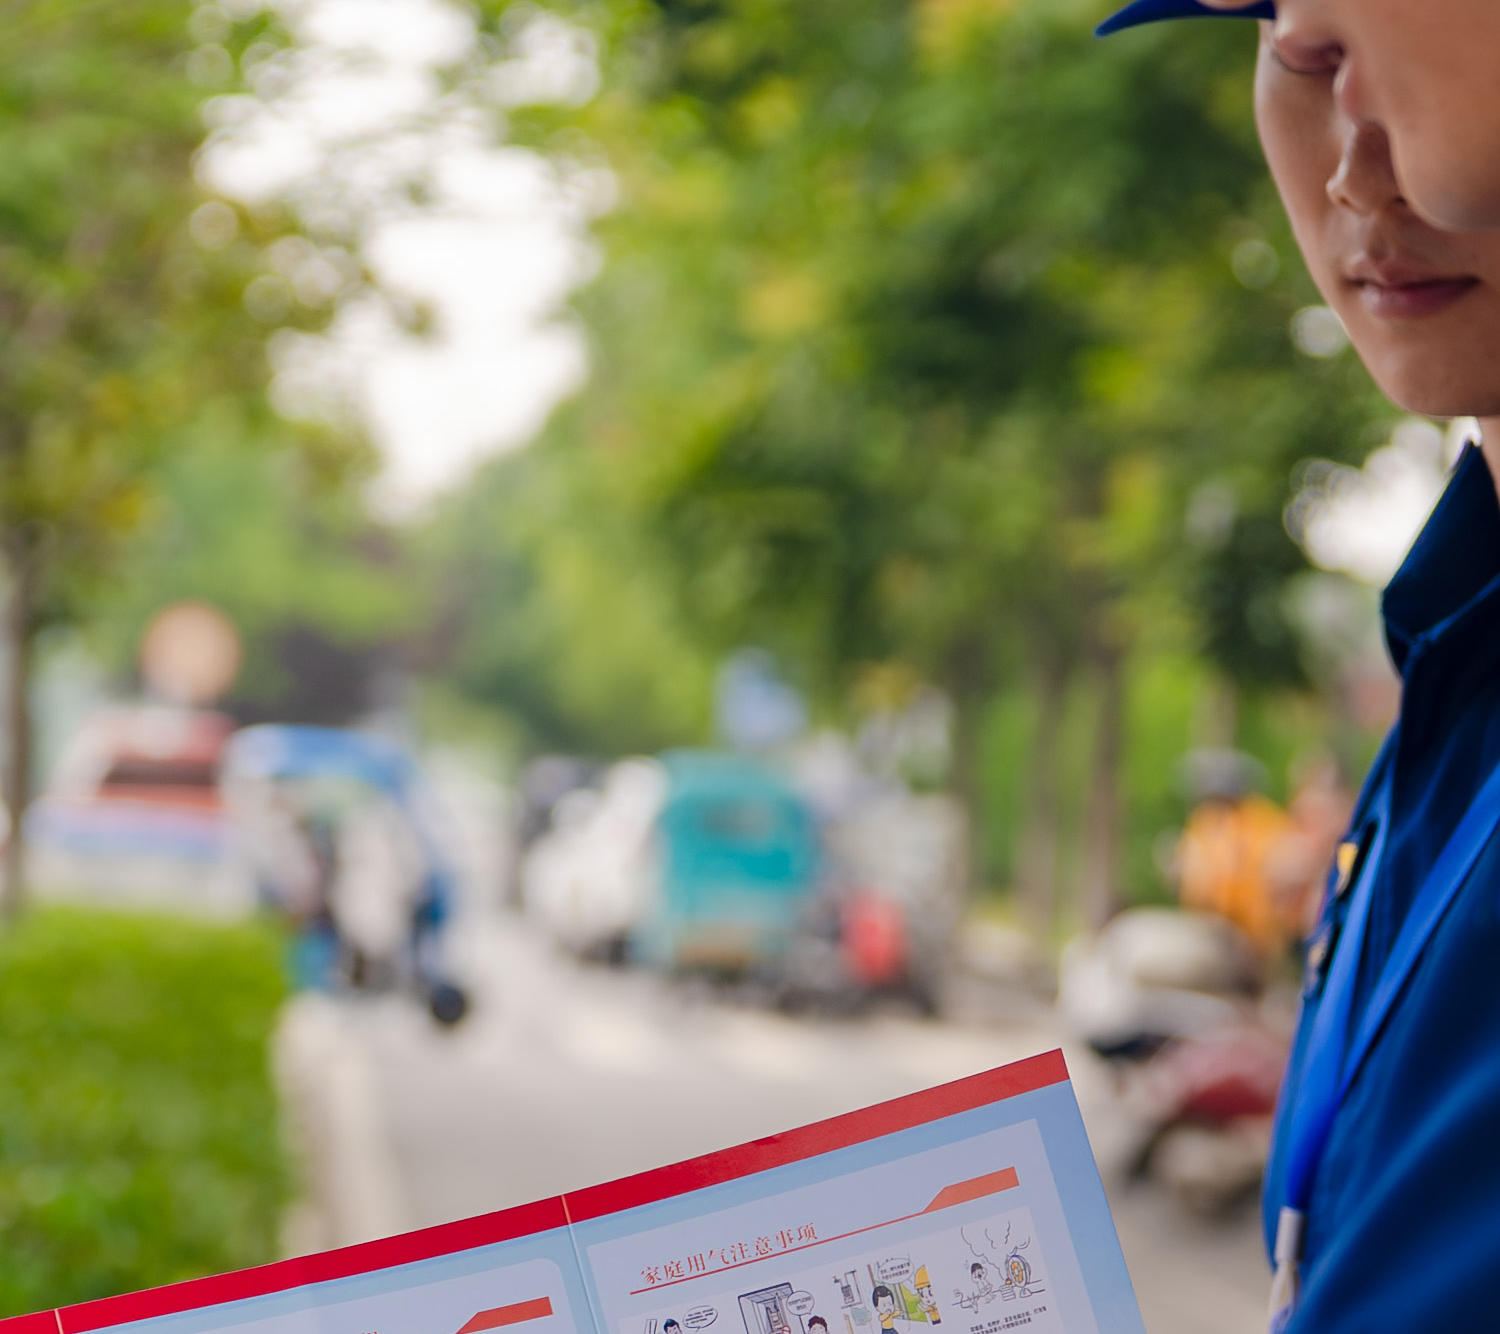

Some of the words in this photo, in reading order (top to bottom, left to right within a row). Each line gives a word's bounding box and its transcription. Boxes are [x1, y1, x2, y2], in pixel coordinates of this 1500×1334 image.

[640, 1222, 818, 1285] 家庭用气注意事项
